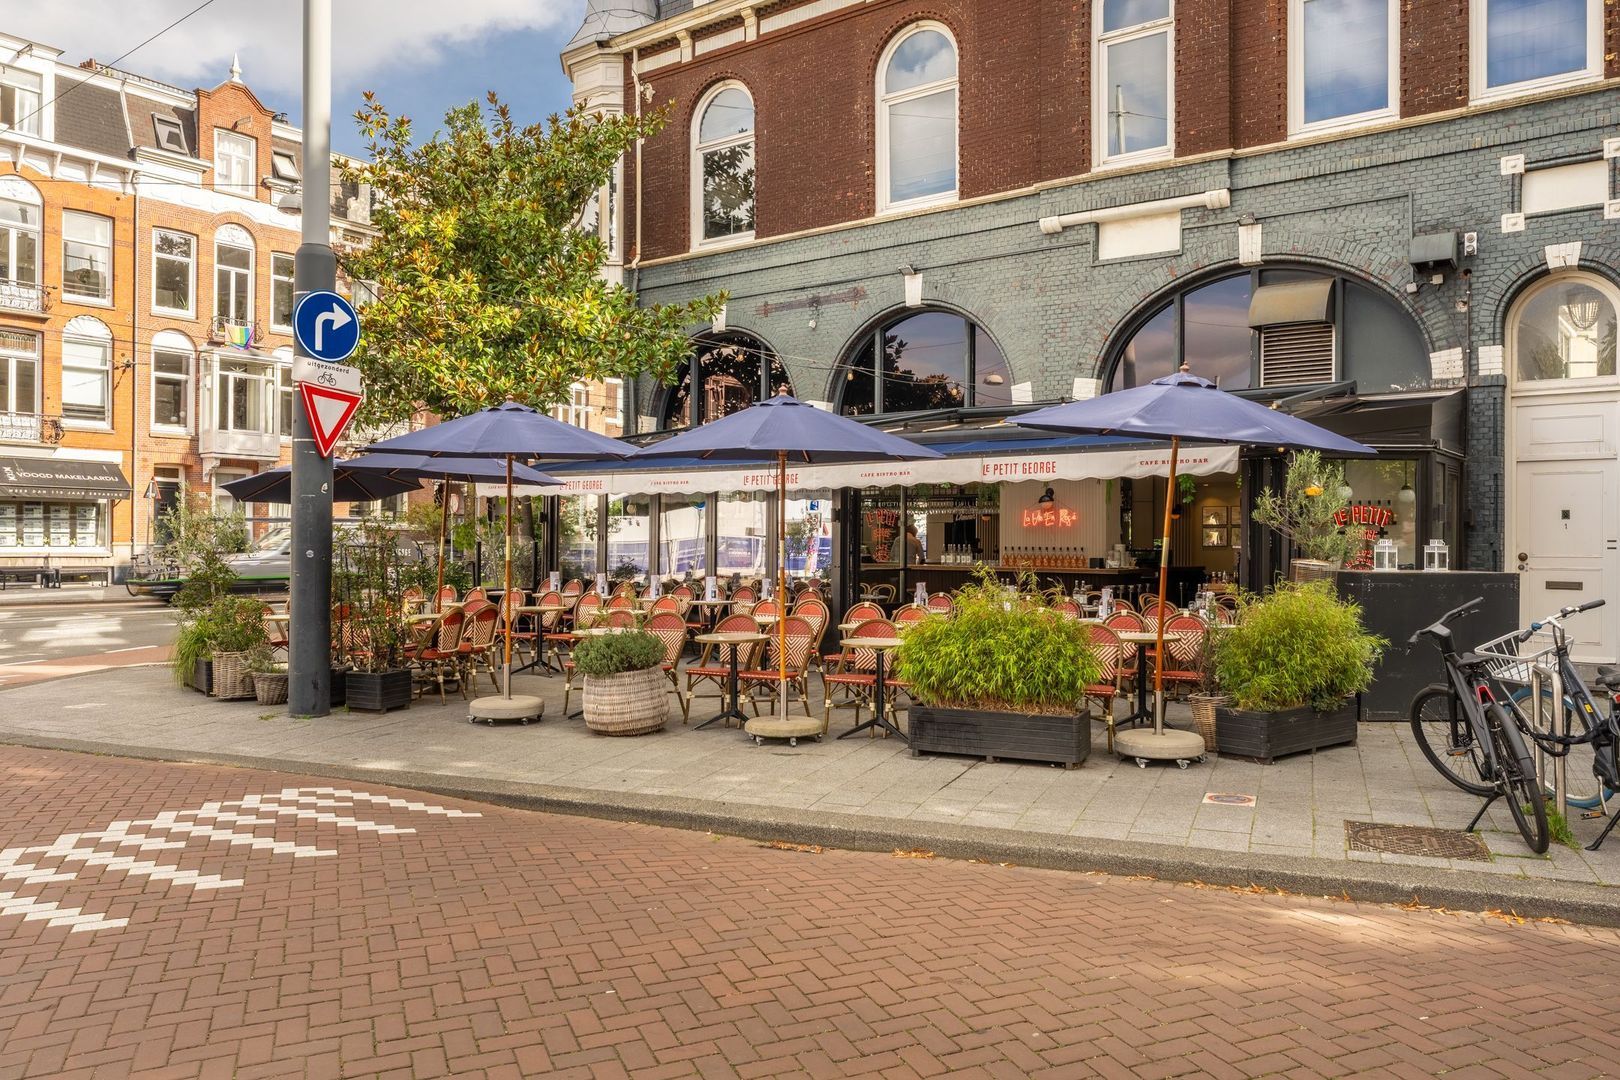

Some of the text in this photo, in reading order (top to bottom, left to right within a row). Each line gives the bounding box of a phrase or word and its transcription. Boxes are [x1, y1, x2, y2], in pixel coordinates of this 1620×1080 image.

[307, 361, 349, 374] uitgezonderd
[993, 463, 1018, 476] PETIT
[1021, 461, 1056, 475] GEORGE
[55, 473, 119, 482] MAKELAARDIJ
[751, 475, 769, 486] PETIT
[772, 473, 799, 485] GERGE
[566, 481, 580, 491] PETIT
[582, 480, 603, 490] GEORGE
[1333, 505, 1391, 528] LE PETIT
